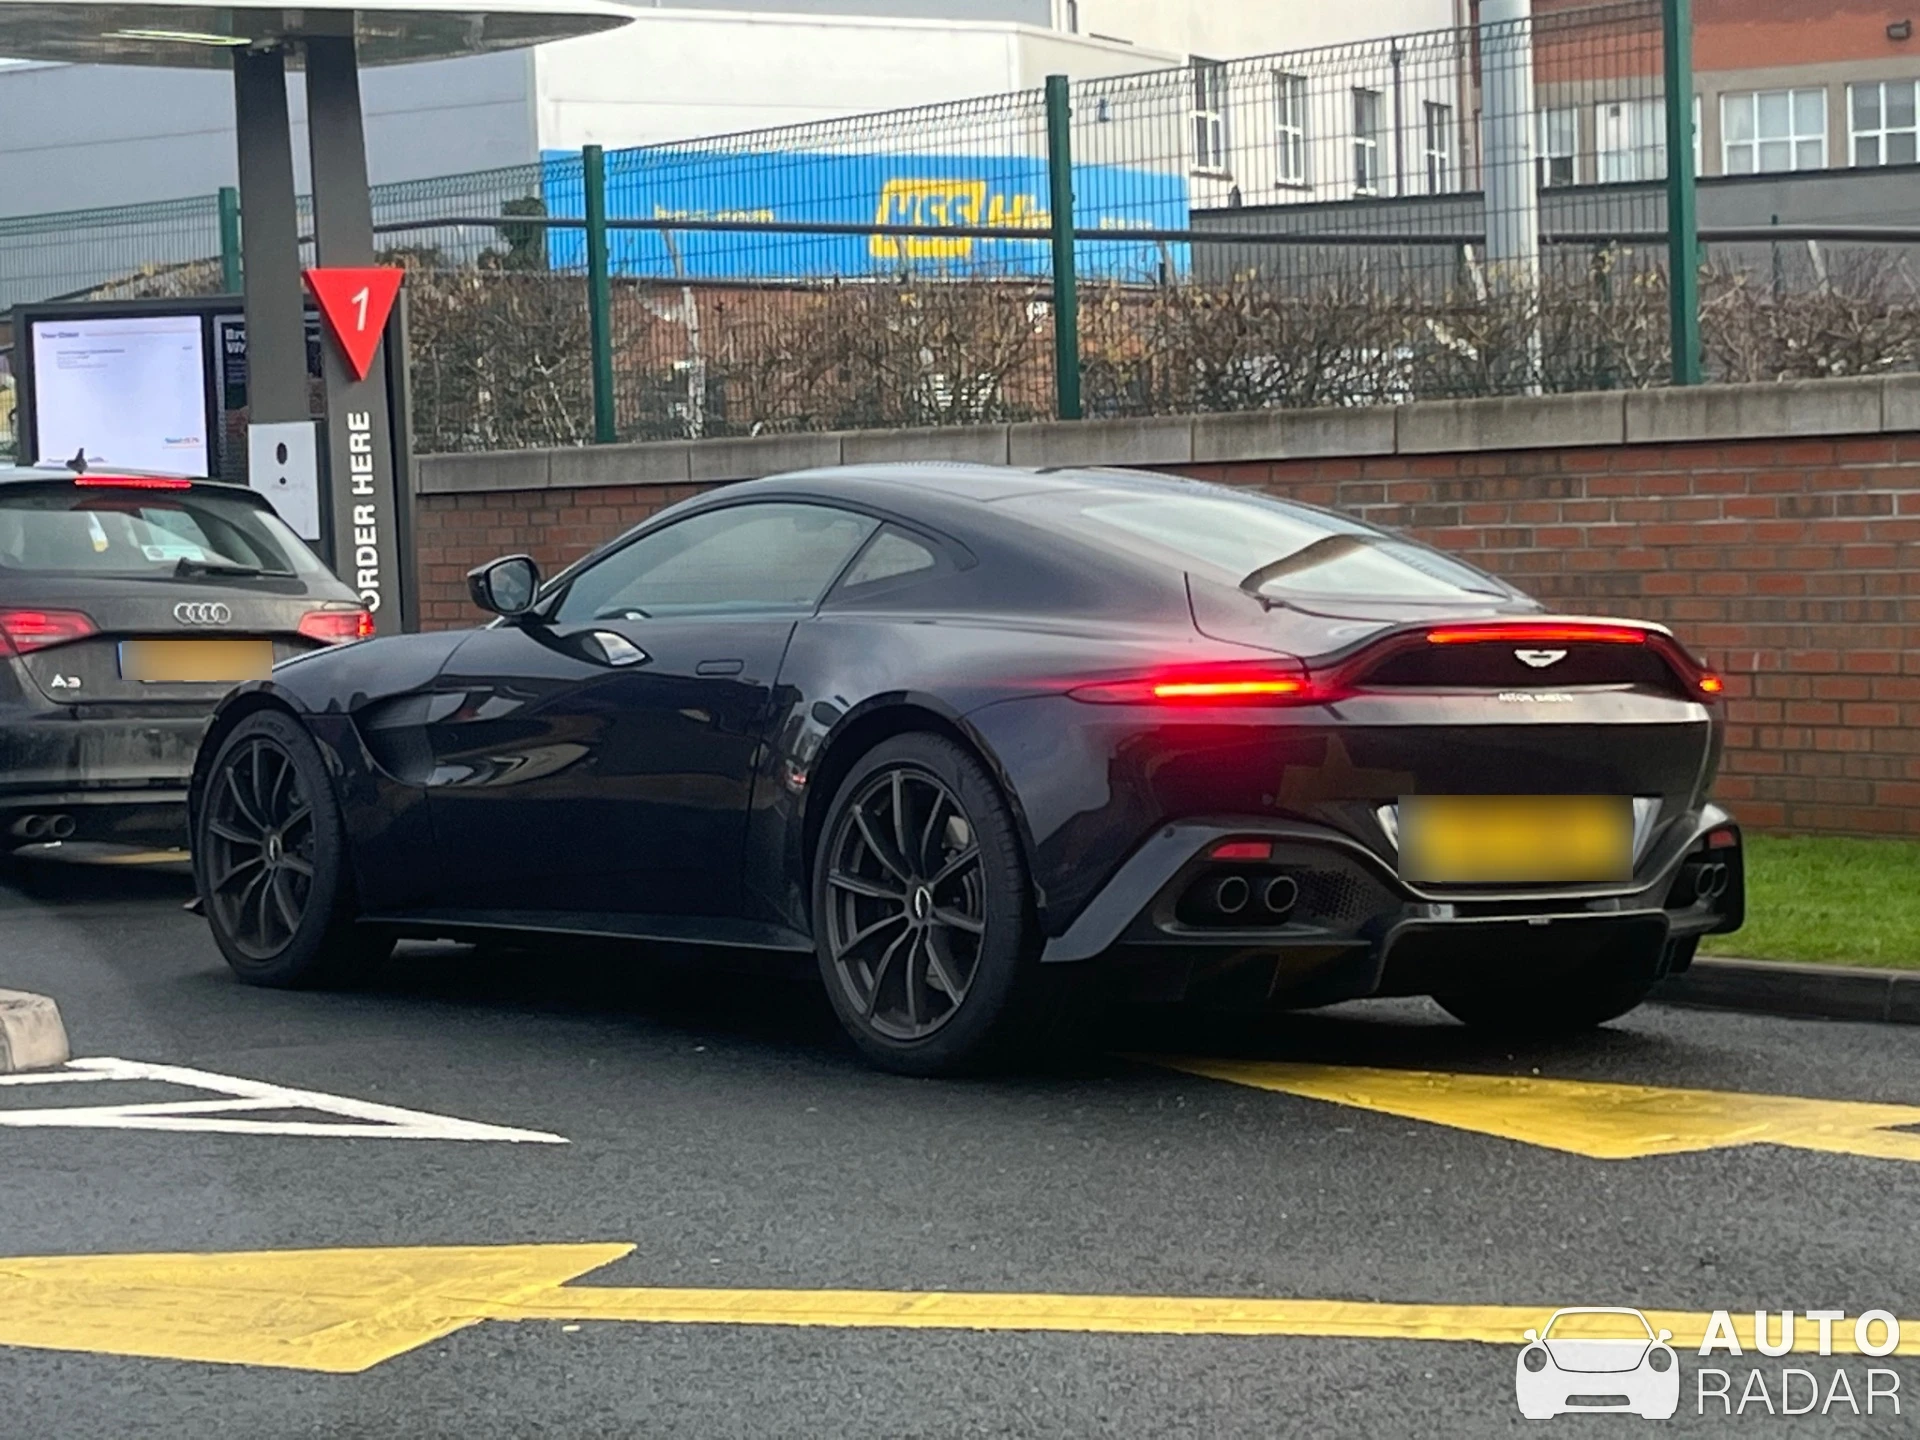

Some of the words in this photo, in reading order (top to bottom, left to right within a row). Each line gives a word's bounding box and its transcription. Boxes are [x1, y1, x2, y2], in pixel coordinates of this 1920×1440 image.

[351, 286, 370, 331] 1
[347, 411, 374, 495] HERE
[354, 504, 381, 612] ORDER
[51, 673, 82, 689] A3
